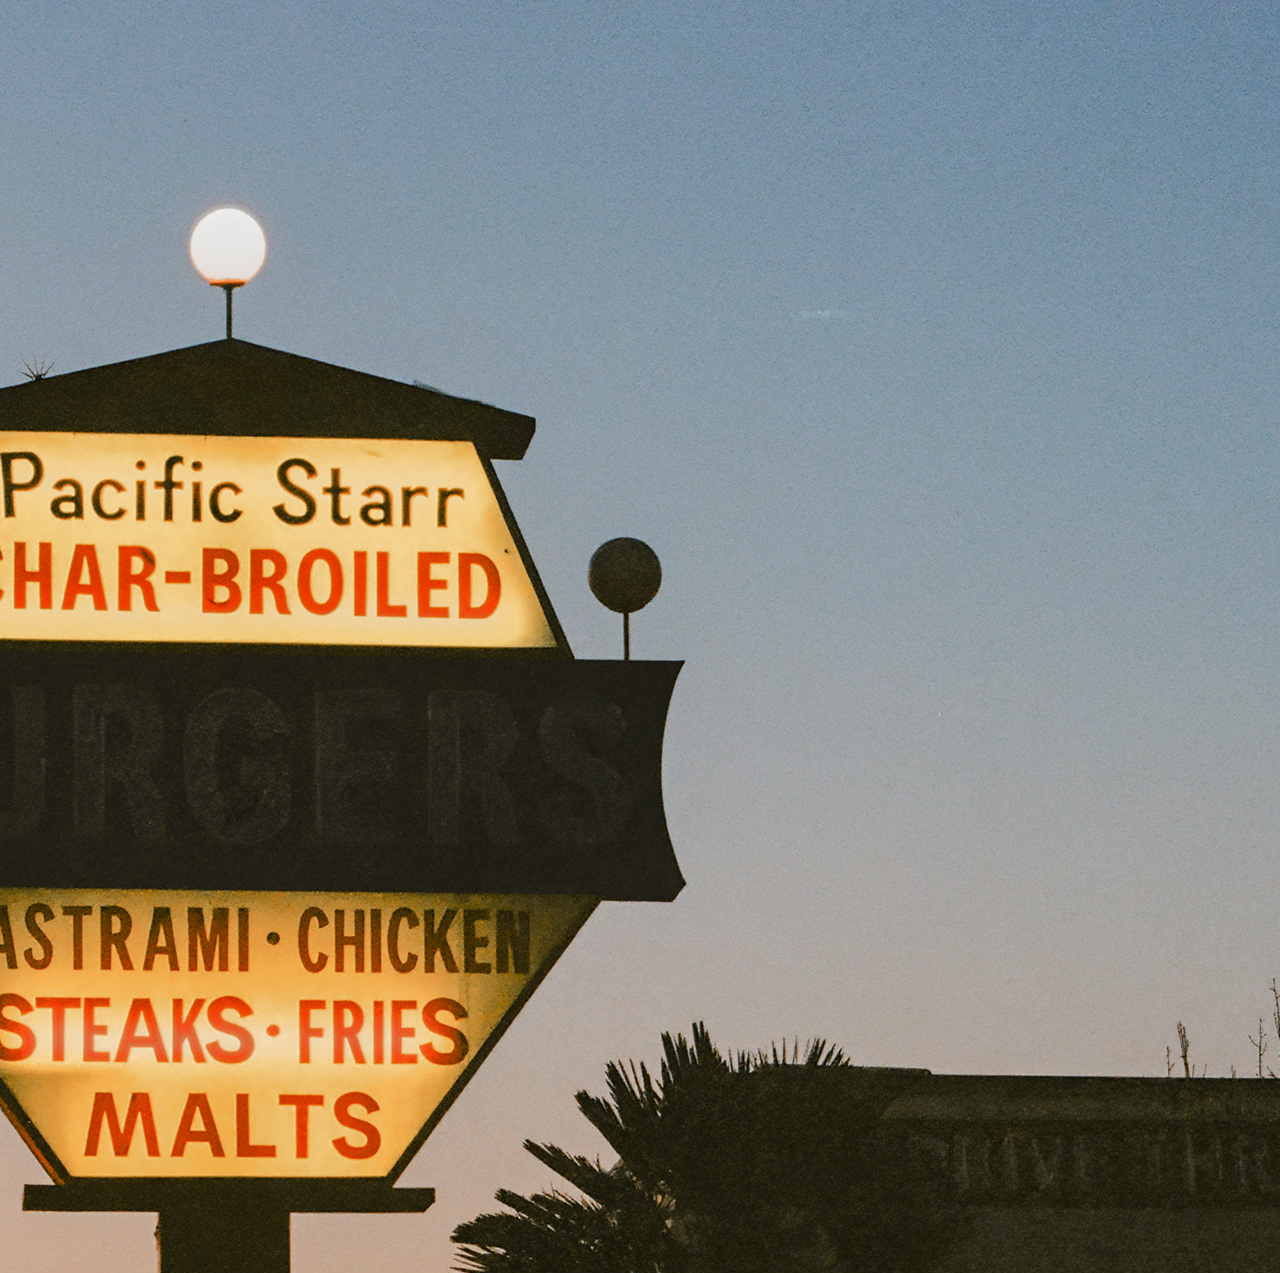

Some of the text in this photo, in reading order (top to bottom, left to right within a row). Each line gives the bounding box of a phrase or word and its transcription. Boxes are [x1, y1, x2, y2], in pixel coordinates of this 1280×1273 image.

[0, 451, 465, 528] Pacific Starr
[297, 907, 532, 976] CHICKEN
[298, 997, 470, 1066] FRIES
[83, 1091, 382, 1159] MALTS
